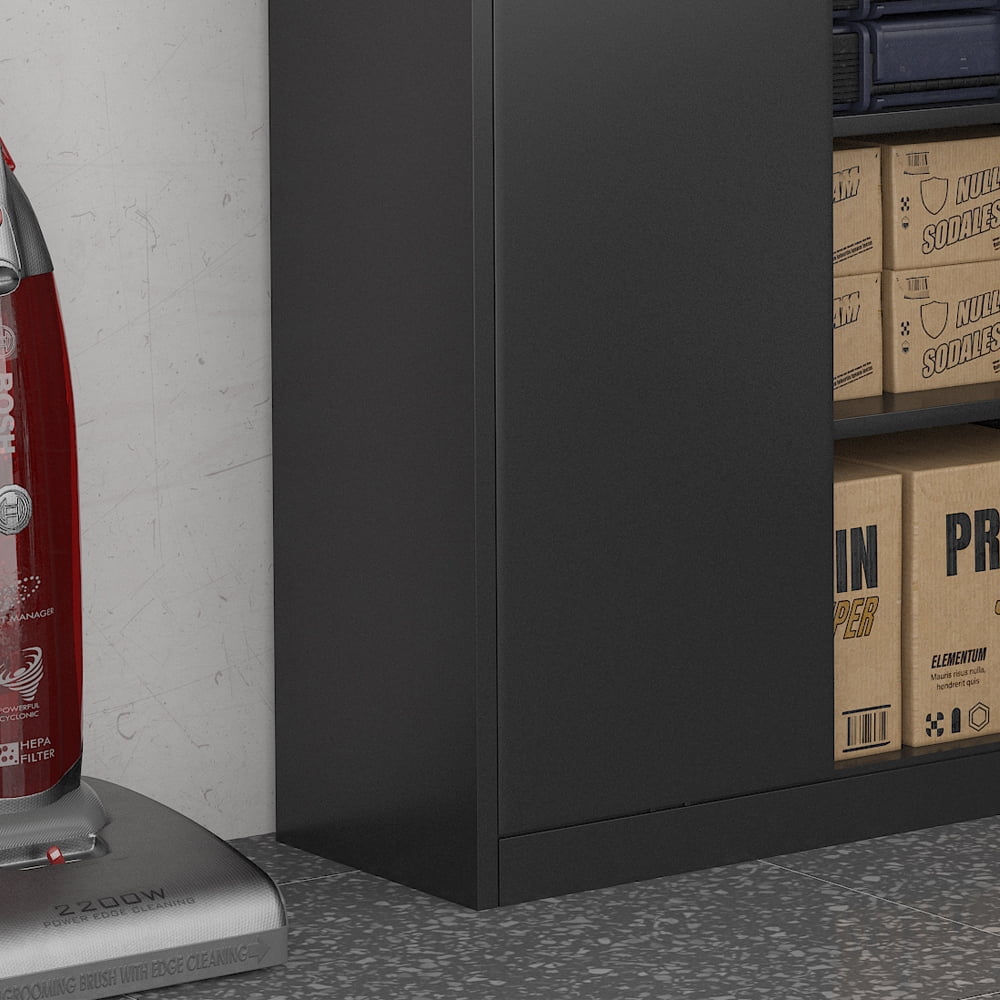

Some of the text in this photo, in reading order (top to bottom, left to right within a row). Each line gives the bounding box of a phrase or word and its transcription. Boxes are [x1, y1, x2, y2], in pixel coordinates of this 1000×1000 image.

[835, 524, 879, 593] IN
[10, 607, 55, 622] MANAGER
[833, 595, 880, 640] PER
[931, 647, 987, 669] ELEMENTUM
[0, 710, 40, 722] CYCLONIC
[20, 736, 51, 750] HEPA
[20, 748, 55, 764] FILTER
[43, 896, 196, 928] POWER EDGE CLEANING
[54, 887, 166, 916] 2200W
[80, 967, 117, 991] BRUSH
[119, 961, 149, 985] WITH
[151, 955, 184, 978] EDGE
[186, 945, 249, 972] CLEANING
